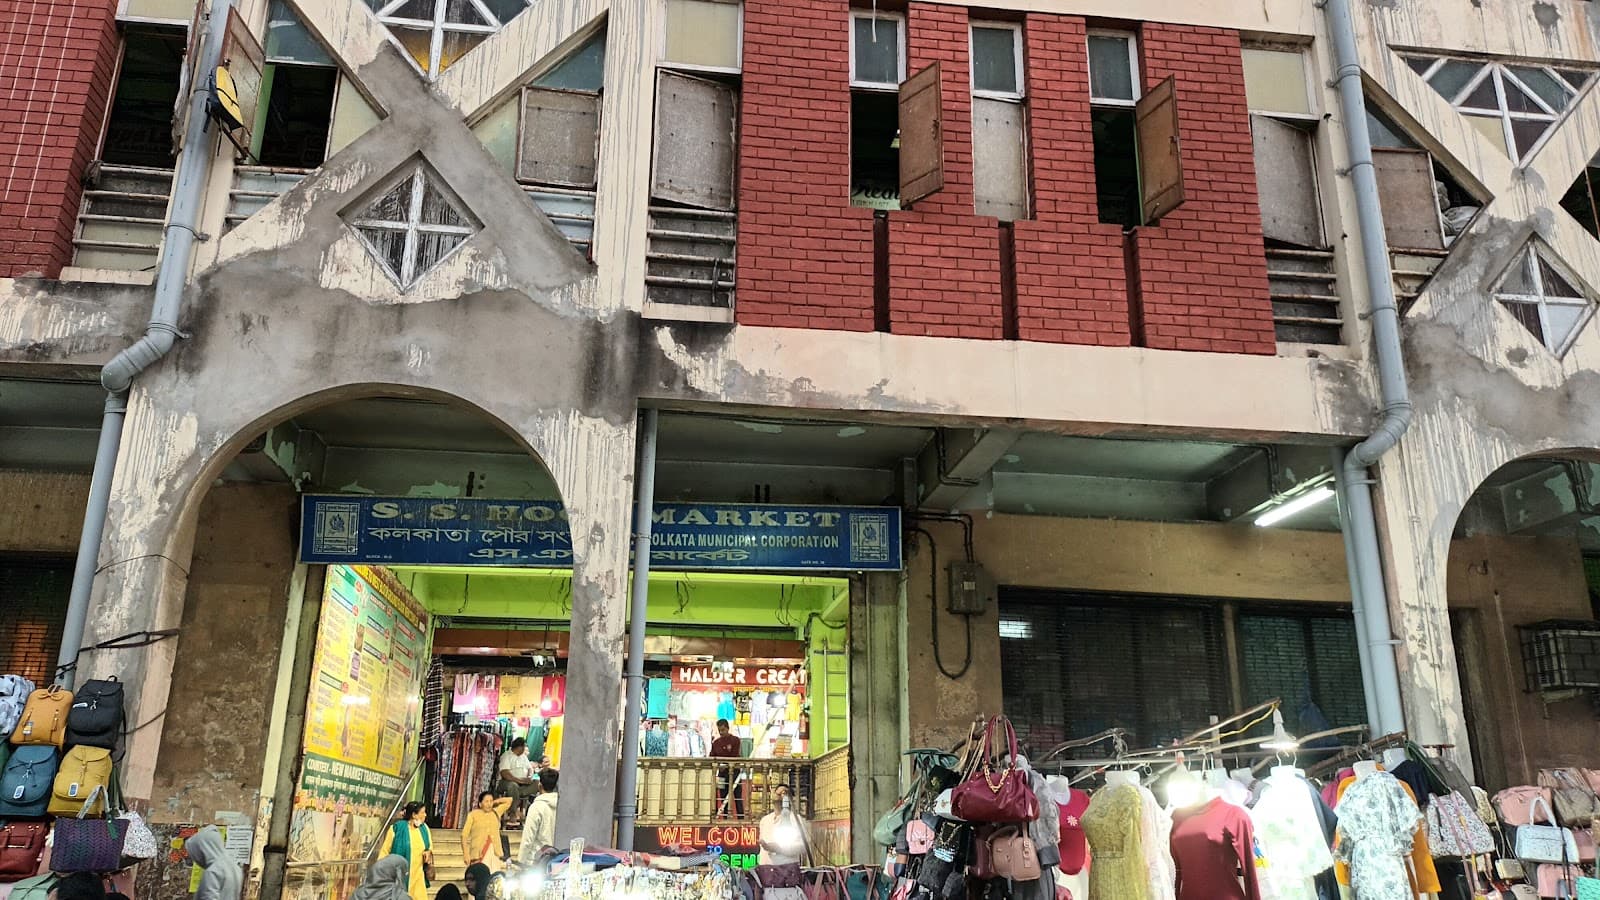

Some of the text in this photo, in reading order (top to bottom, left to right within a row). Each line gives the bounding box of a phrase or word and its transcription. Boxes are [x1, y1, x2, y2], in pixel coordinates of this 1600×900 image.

[371, 502, 414, 520] S.
[428, 503, 471, 521] S.
[651, 509, 841, 528] MARKET
[367, 526, 572, 545] কলকাতা পৌর সং
[650, 533, 839, 548] OLKATA MUNICIPAL CORPORATION
[679, 667, 807, 684] HALDER CREAT
[658, 826, 758, 846] WELCOM
[706, 845, 722, 855] TO
